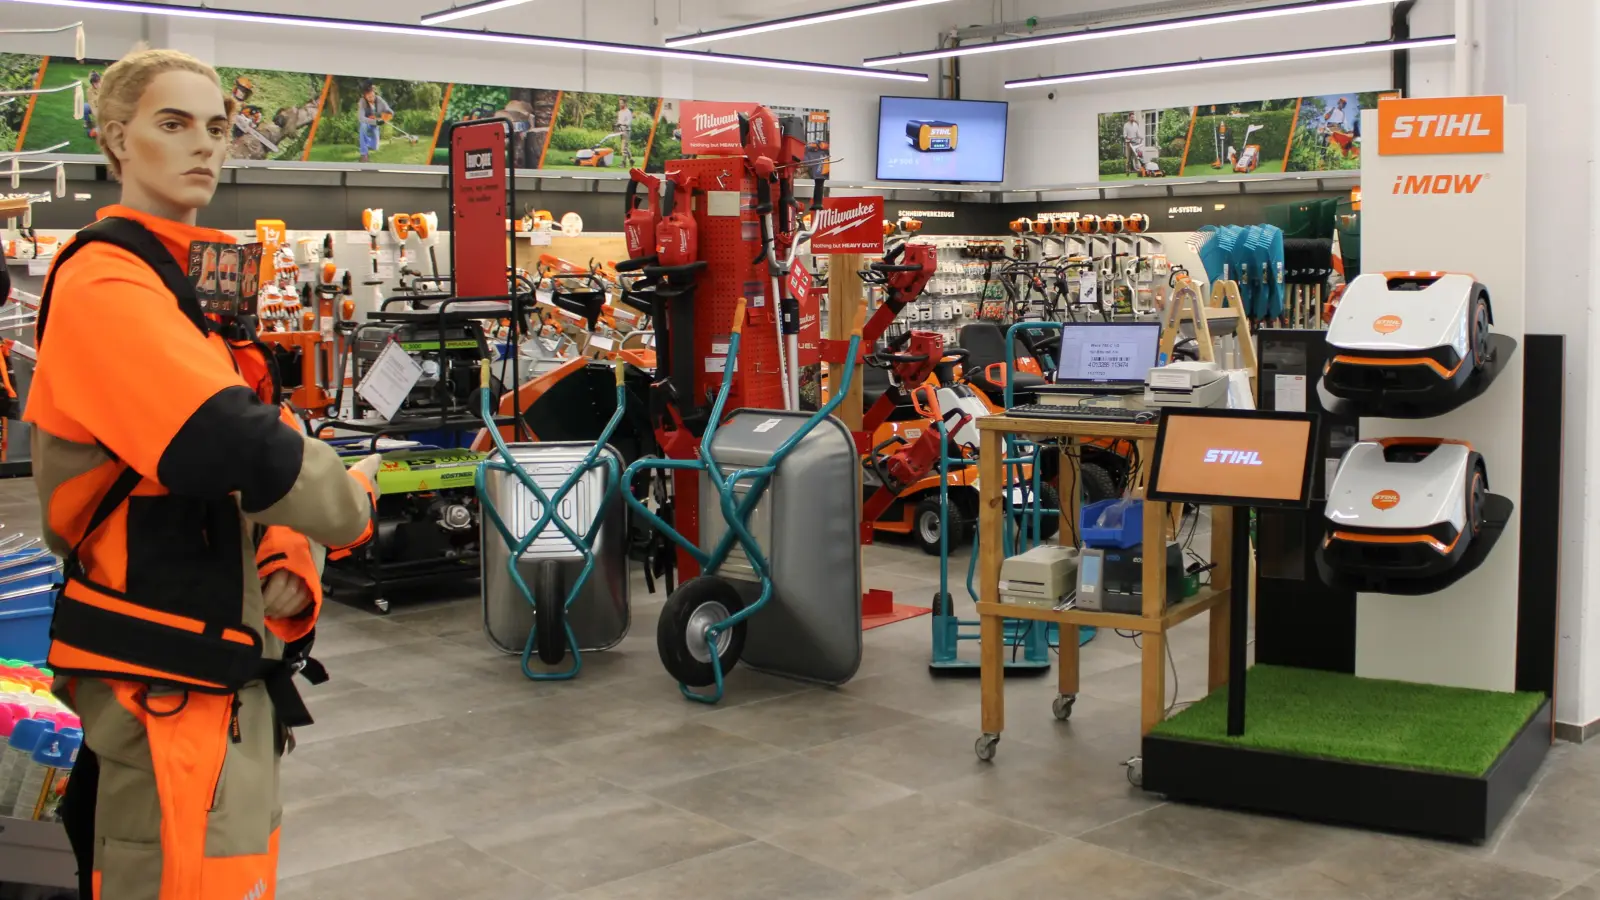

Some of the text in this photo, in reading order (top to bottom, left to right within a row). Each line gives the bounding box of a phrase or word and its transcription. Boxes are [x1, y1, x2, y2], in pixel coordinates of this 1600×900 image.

[692, 110, 740, 132] Milwauk
[1391, 114, 1491, 138] STIHL
[816, 202, 875, 231] Milwaukee
[898, 210, 955, 218] SCHNEIDWERKZEUGE
[1168, 206, 1203, 214] AK-SYSTEM
[1204, 449, 1263, 465] STIHL
